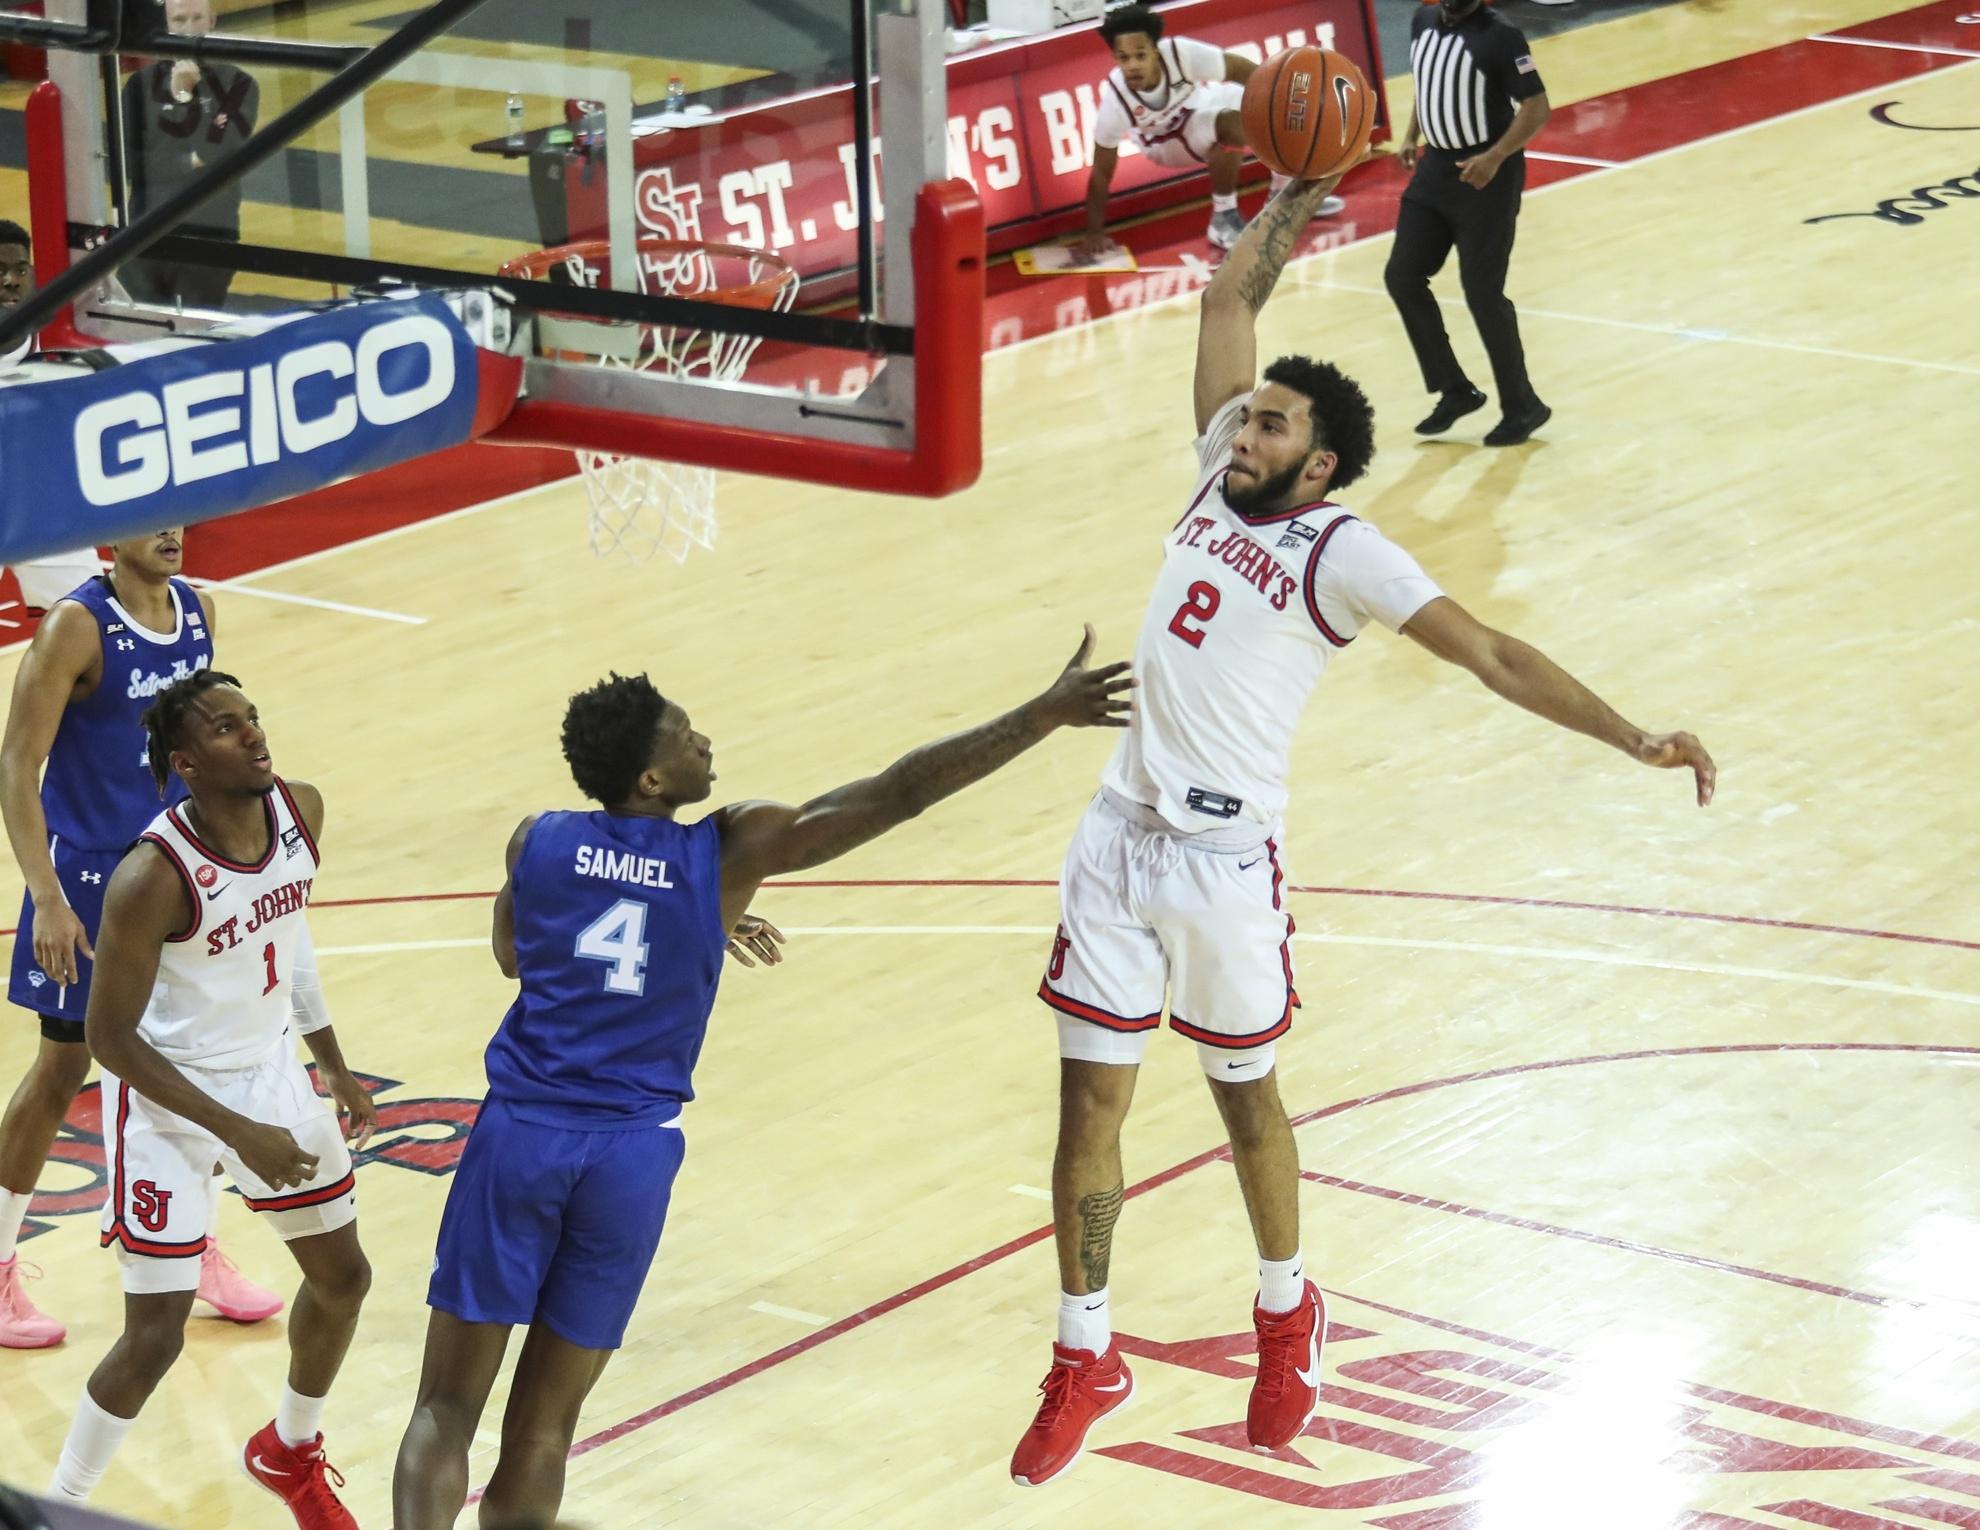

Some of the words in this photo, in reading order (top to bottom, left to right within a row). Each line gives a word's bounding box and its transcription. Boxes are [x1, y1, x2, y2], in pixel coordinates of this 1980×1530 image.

[1286, 71, 1312, 133] ELITE
[74, 315, 456, 506] GEICO
[1176, 516, 1218, 549] ST.
[1207, 531, 1298, 612] JOHN'S
[1167, 579, 1222, 650] 2
[574, 844, 675, 889] SAMUEL
[206, 914, 244, 957] ST.
[573, 897, 651, 998] 4
[262, 941, 280, 997] 1
